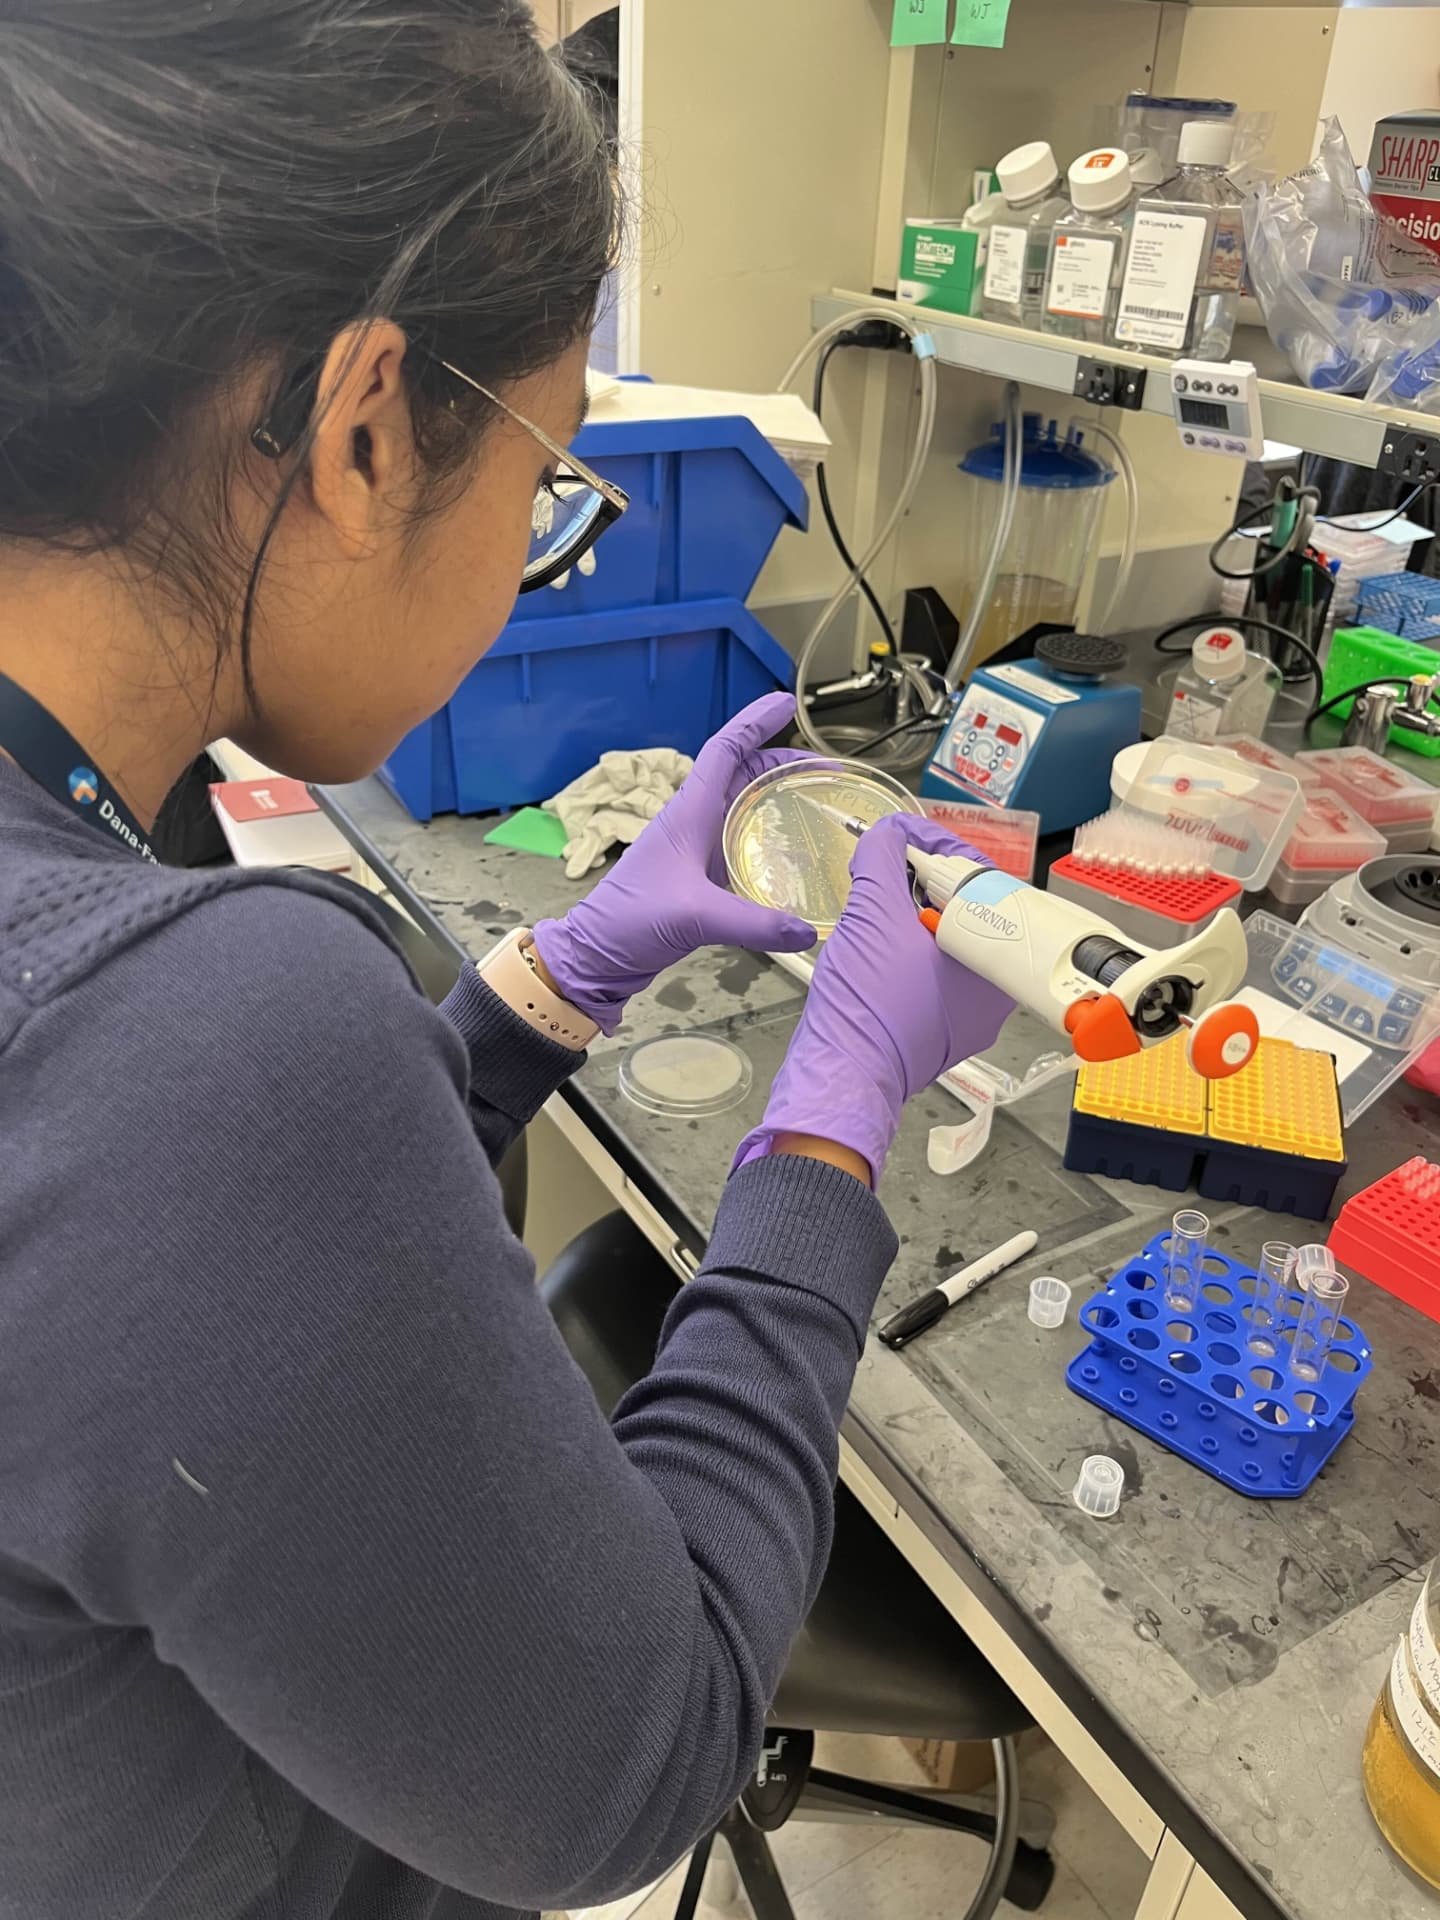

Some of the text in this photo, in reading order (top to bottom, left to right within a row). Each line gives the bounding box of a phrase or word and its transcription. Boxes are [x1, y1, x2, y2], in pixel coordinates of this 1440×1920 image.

[1377, 136, 1440, 192] SHARP
[99, 799, 161, 868] Dana-Fa
[966, 901, 1018, 936] CORNING
